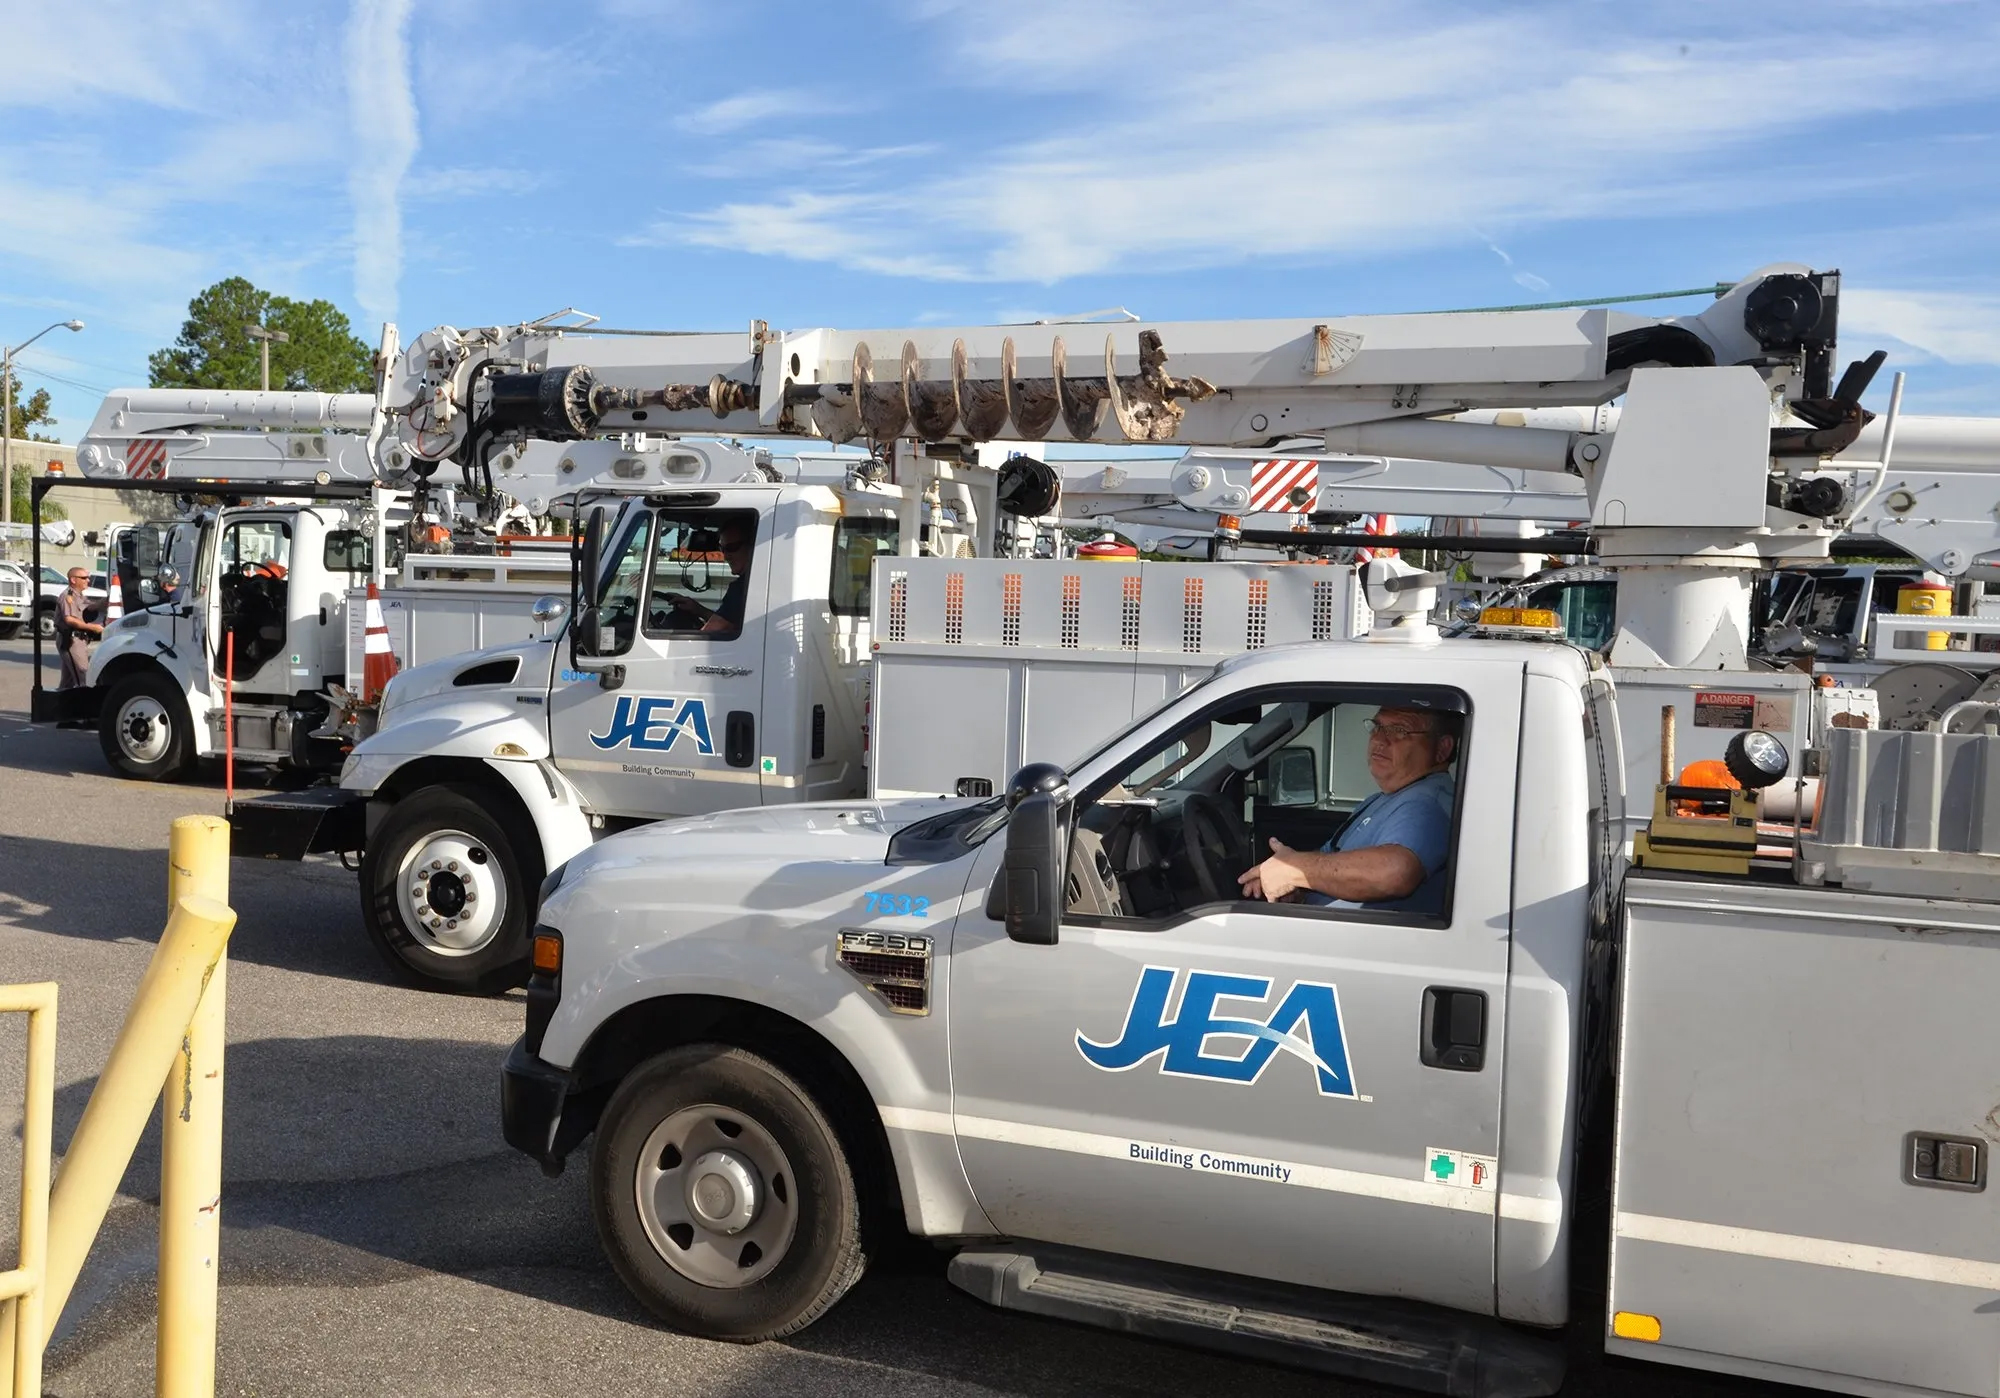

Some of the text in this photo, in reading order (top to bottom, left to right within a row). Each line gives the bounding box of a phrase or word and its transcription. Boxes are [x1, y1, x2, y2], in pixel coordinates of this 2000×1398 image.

[1709, 694, 1751, 705] DANGER
[588, 695, 716, 756] JEA
[622, 764, 696, 780] Building Community
[864, 891, 929, 918] 7532
[880, 947, 905, 956] SUPER
[1074, 963, 1360, 1101] JEA
[1130, 1143, 1291, 1182] Building Community
